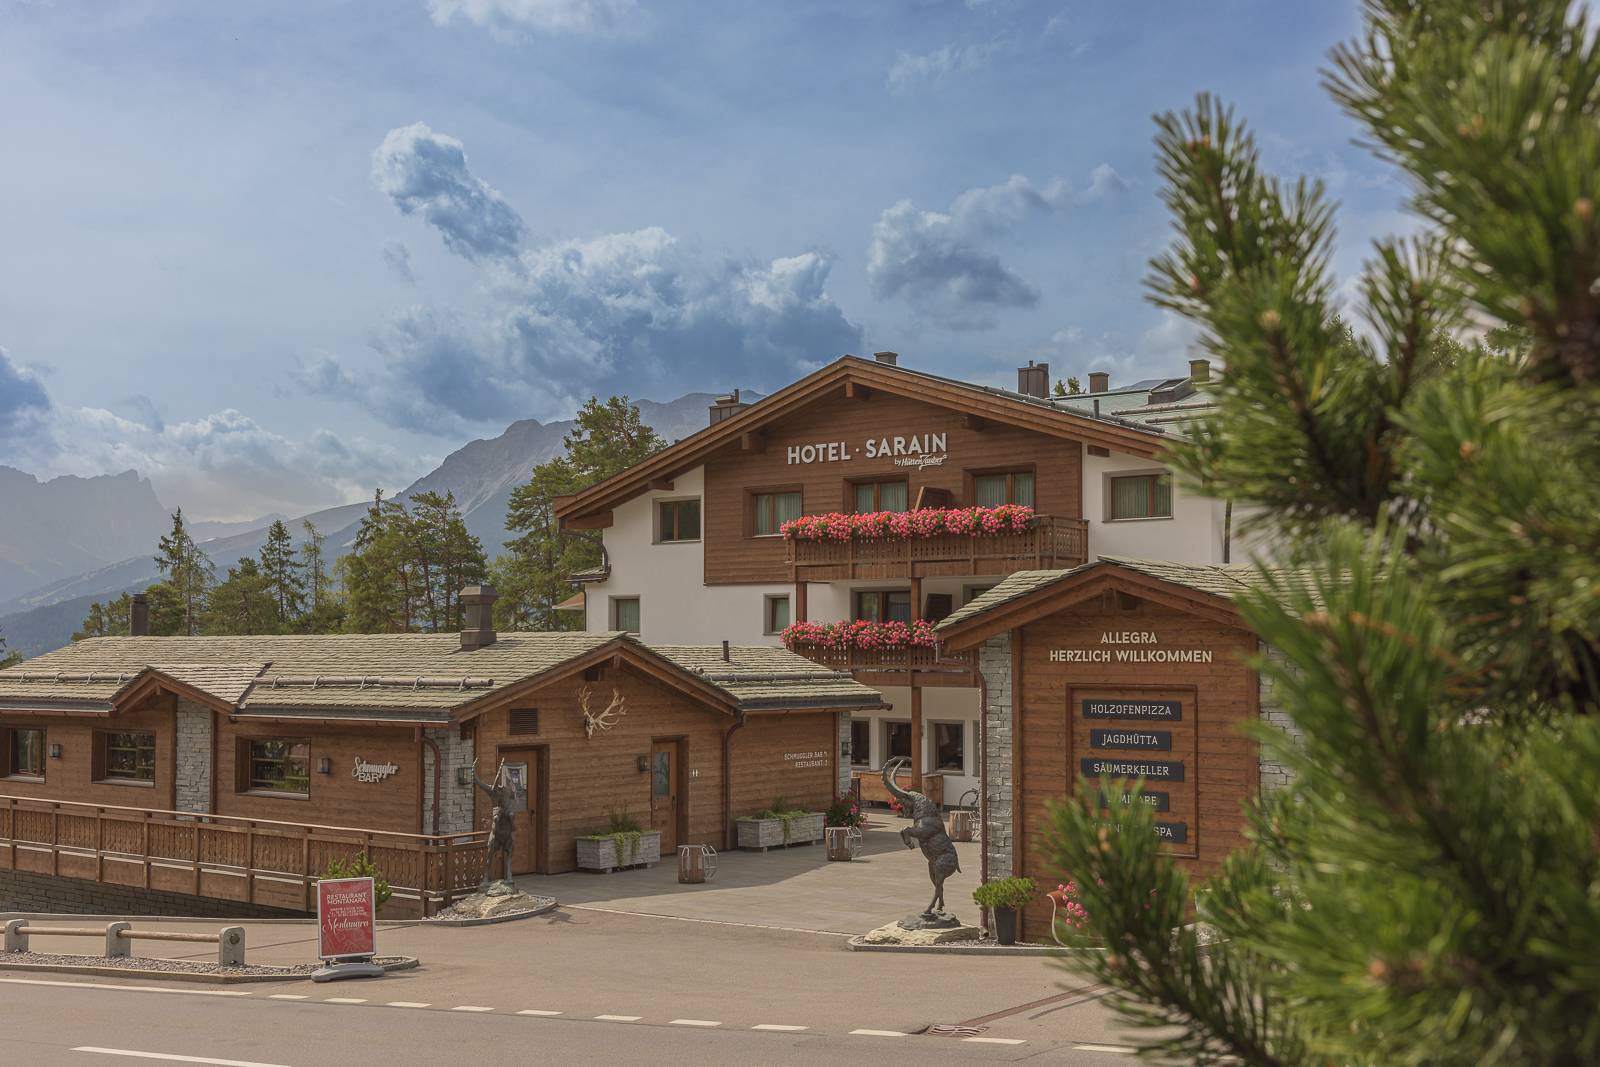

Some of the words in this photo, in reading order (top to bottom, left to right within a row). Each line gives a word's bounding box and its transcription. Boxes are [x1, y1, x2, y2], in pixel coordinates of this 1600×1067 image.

[787, 441, 851, 465] HOTEL
[865, 432, 947, 458] SARAIN
[894, 458, 901, 467] by
[1100, 631, 1158, 644] ALLEGRA
[1049, 650, 1111, 662] HERZLICH
[1115, 650, 1213, 663] WILLKOMMEN
[1090, 704, 1172, 715] HOLZOFENPIZZA
[1101, 733, 1158, 746] JAGDHÜTTA
[351, 756, 399, 779] Schmuggler
[795, 760, 823, 768] RESTAURANT
[1093, 762, 1169, 776] SÄUMERKELLER
[358, 773, 380, 783] BAR
[1153, 826, 1173, 837] SPA
[326, 892, 367, 900] RESTAURANT
